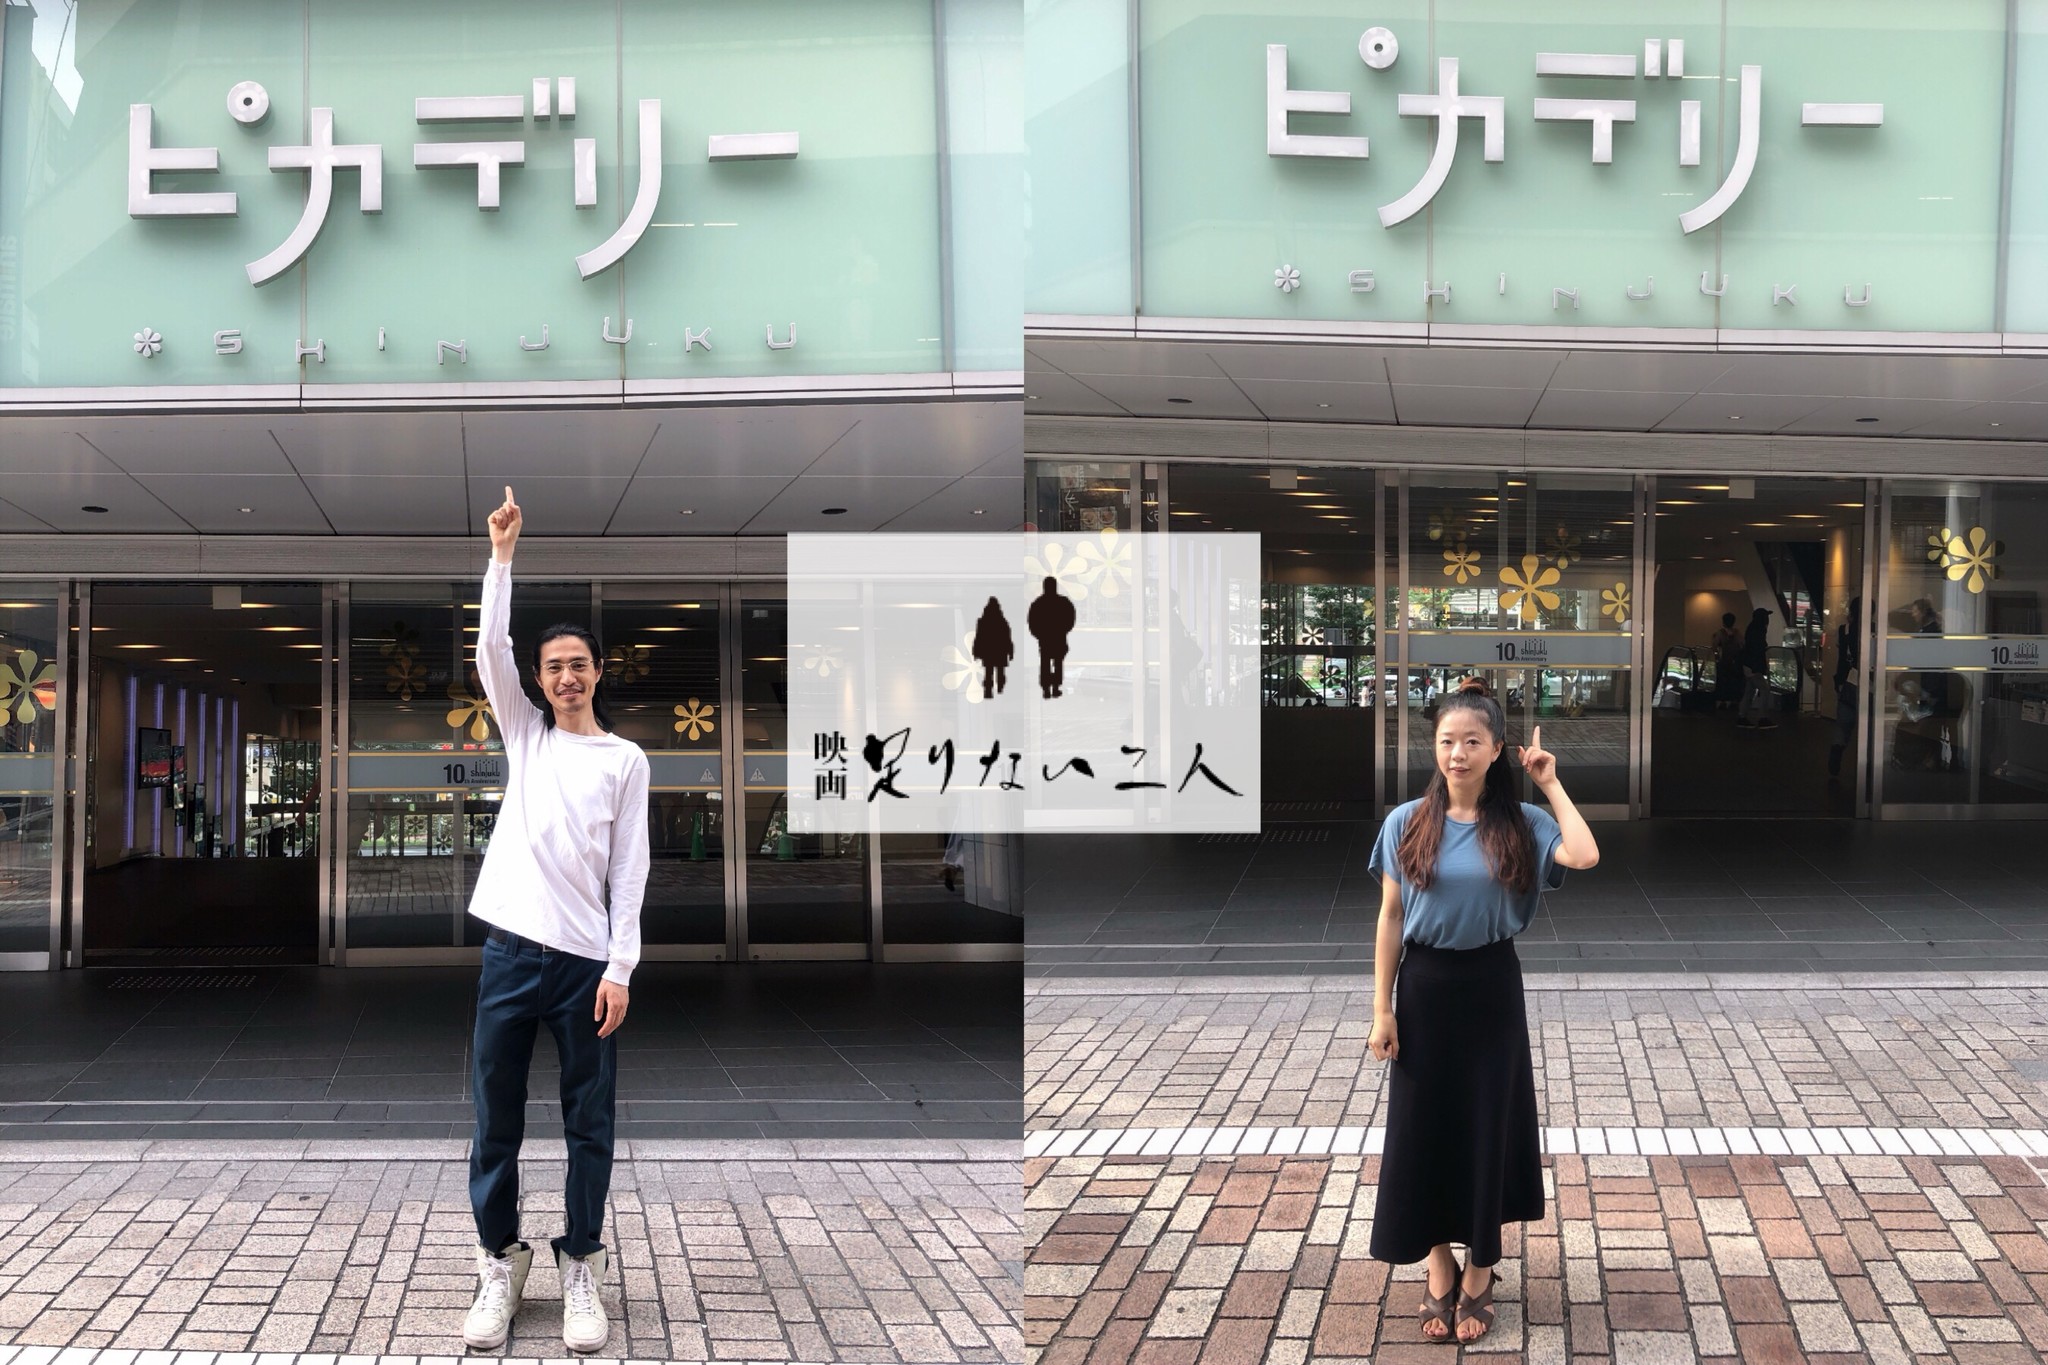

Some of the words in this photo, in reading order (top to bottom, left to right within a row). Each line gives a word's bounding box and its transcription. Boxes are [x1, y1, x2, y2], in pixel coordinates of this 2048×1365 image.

[1266, 26, 1884, 235] ピカデリー
[129, 77, 799, 287] ピカデリー
[1347, 270, 1872, 311] SHINJUKU
[212, 316, 799, 366] SHINJUKU
[1495, 642, 1516, 661] 10
[1991, 646, 2010, 665] 10
[443, 763, 465, 784] 10
